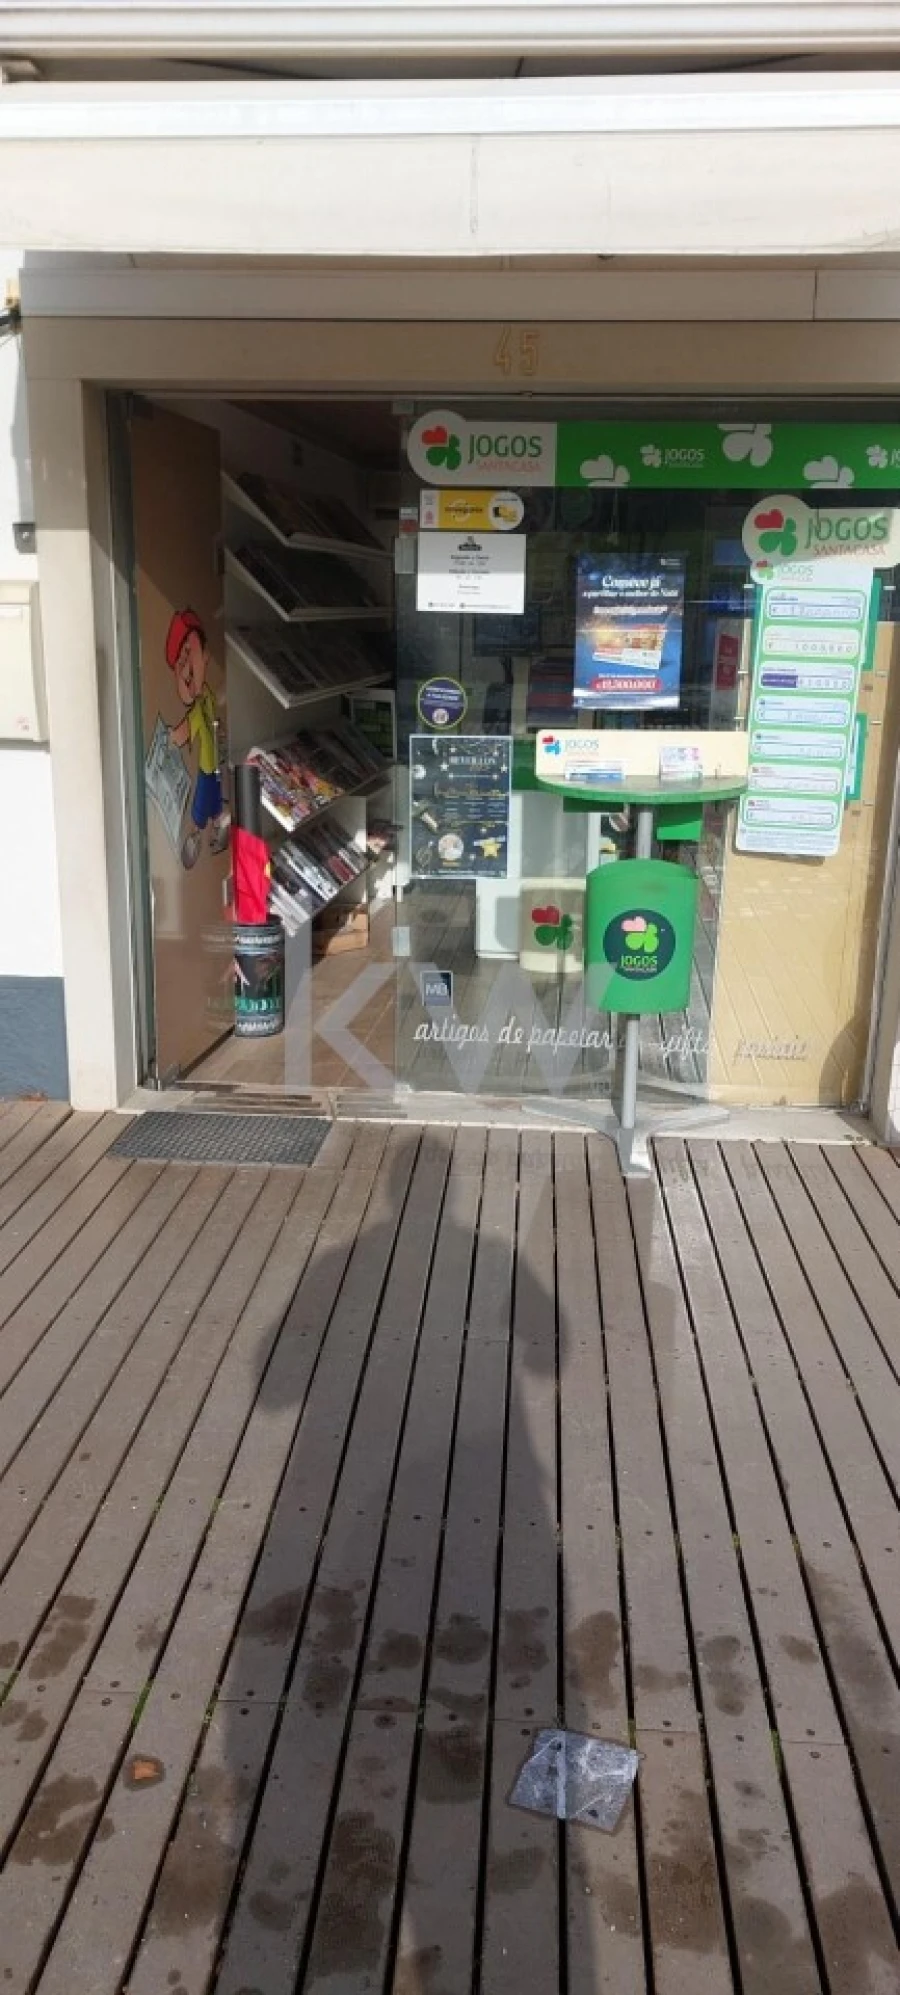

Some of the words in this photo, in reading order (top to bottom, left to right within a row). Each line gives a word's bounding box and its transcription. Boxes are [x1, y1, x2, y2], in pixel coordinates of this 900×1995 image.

[493, 329, 540, 376] 45
[468, 433, 542, 463] JOGOS
[664, 448, 705, 464] JOGOS
[804, 516, 887, 549] JOGOS
[813, 544, 886, 556] SANTACASA
[565, 739, 599, 752] JOGOS
[621, 954, 658, 967] JOGOS
[413, 1013, 489, 1050] artigos
[497, 1015, 524, 1044] de
